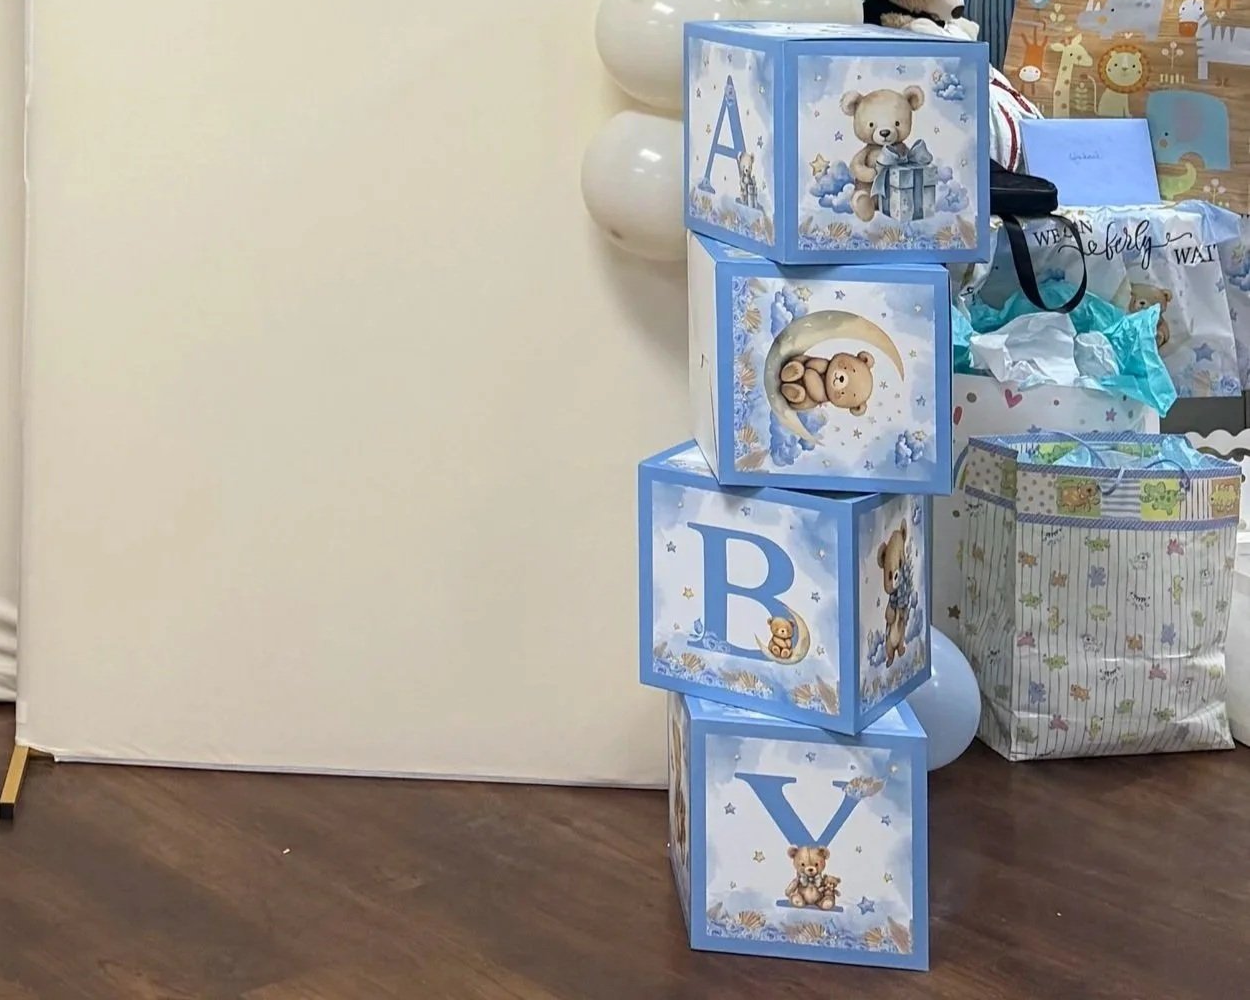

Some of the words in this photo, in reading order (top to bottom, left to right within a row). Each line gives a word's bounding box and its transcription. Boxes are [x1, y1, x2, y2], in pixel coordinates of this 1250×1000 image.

[698, 74, 764, 212] A
[687, 521, 795, 663] B
[734, 772, 868, 913] Y
